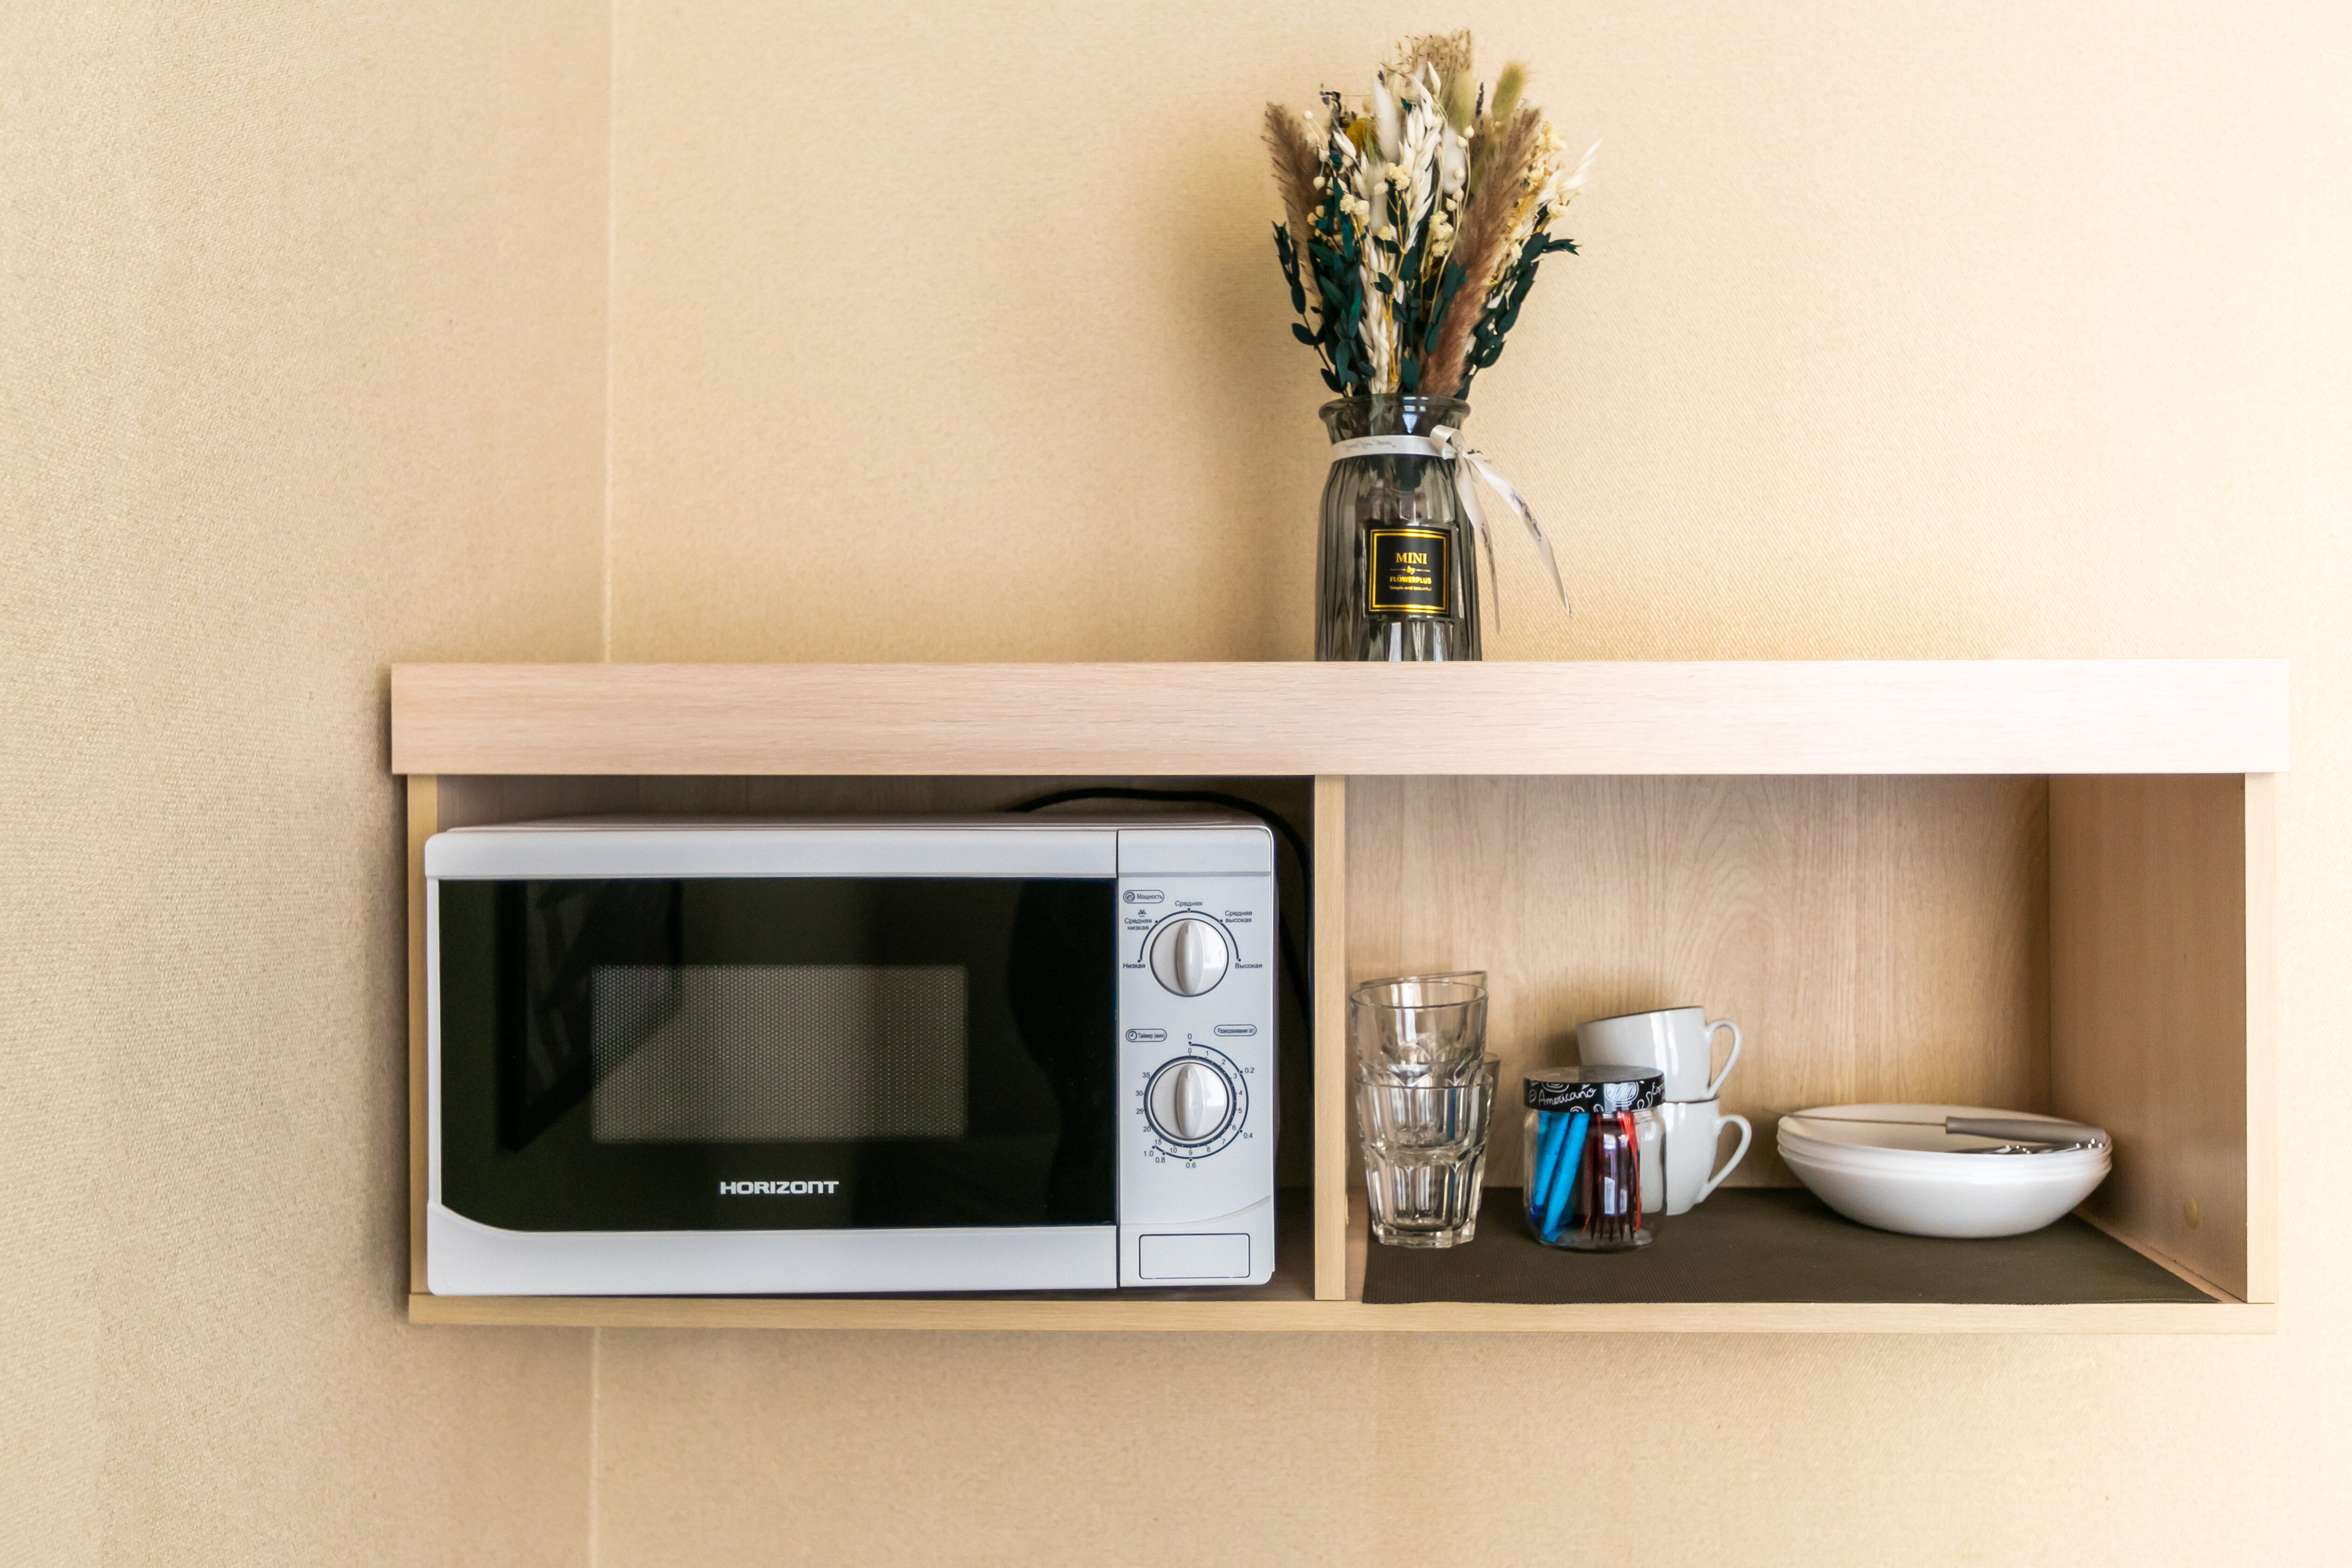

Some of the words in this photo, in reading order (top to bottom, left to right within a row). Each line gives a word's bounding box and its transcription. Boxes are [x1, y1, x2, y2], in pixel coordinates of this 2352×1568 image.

[1396, 553, 1427, 564] MINI
[1539, 1087, 1596, 1106] Americano
[720, 1181, 839, 1194] HORIZONT
